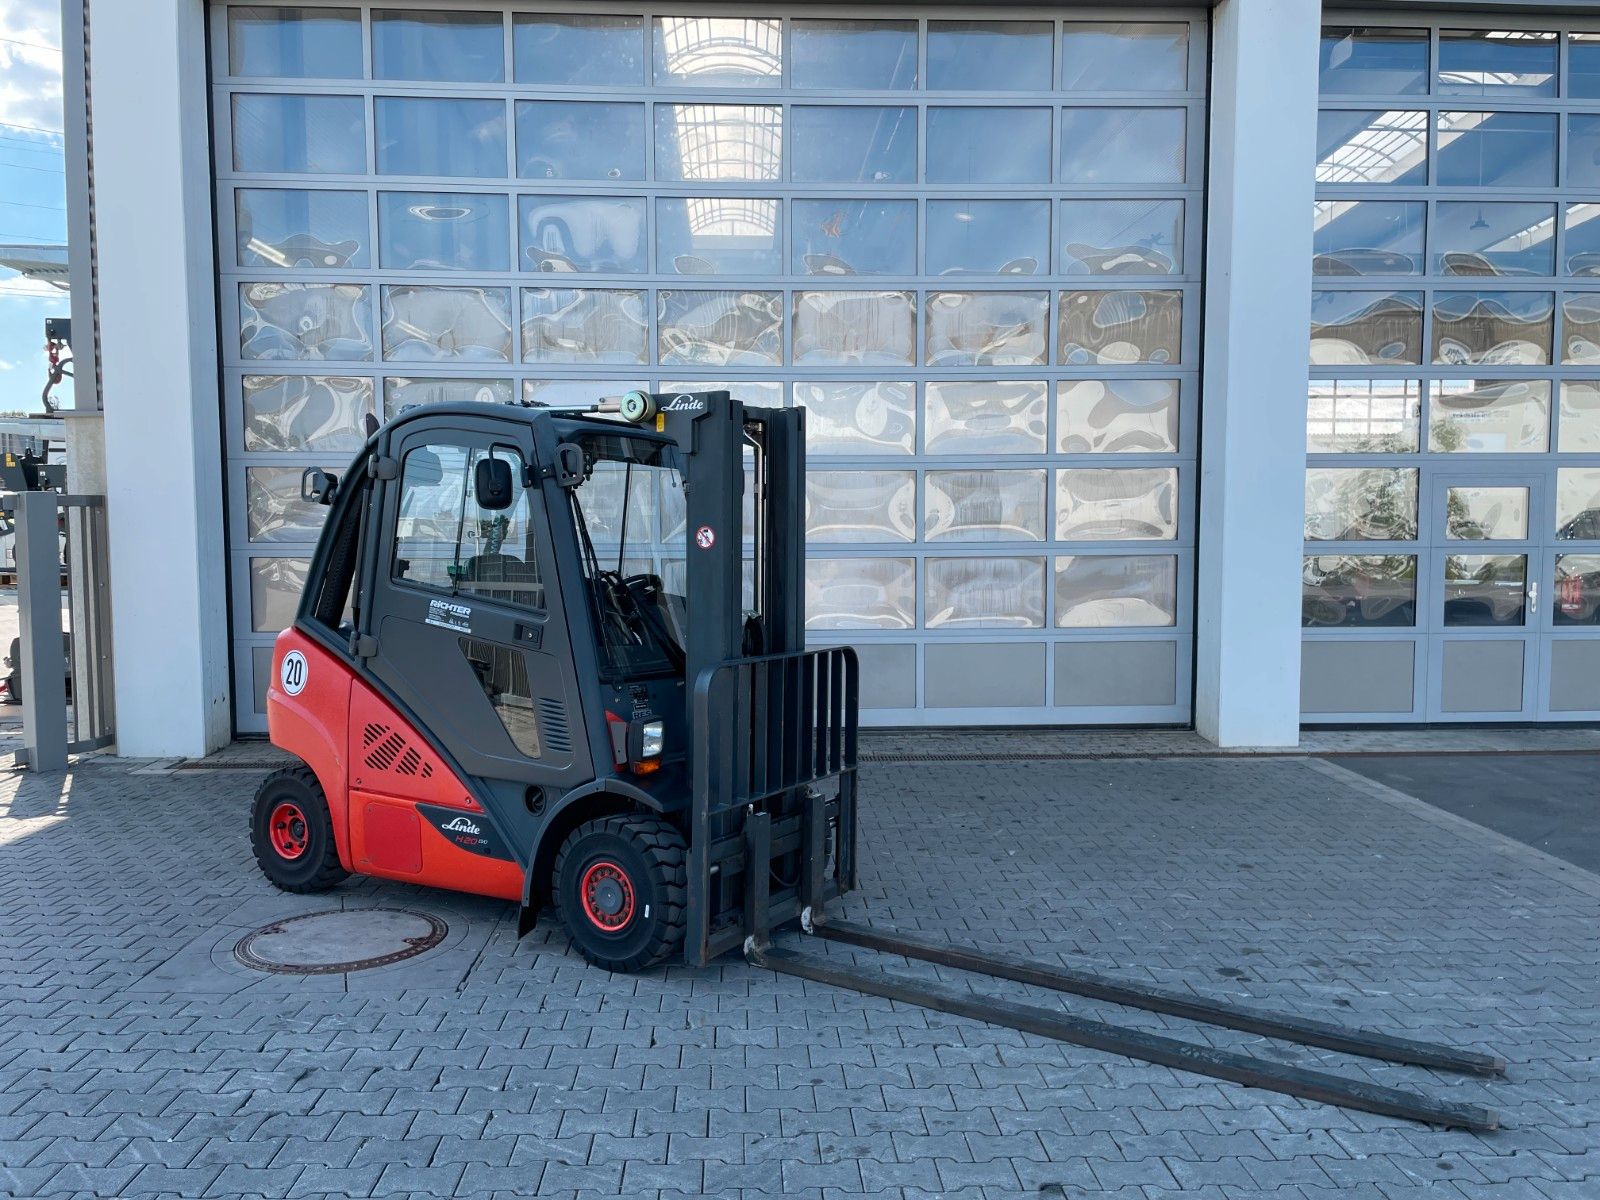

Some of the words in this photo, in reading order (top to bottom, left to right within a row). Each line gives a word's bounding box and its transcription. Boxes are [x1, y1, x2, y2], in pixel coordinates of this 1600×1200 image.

[660, 394, 704, 411] Linde
[286, 658, 302, 686] 20
[441, 817, 480, 835] Linde
